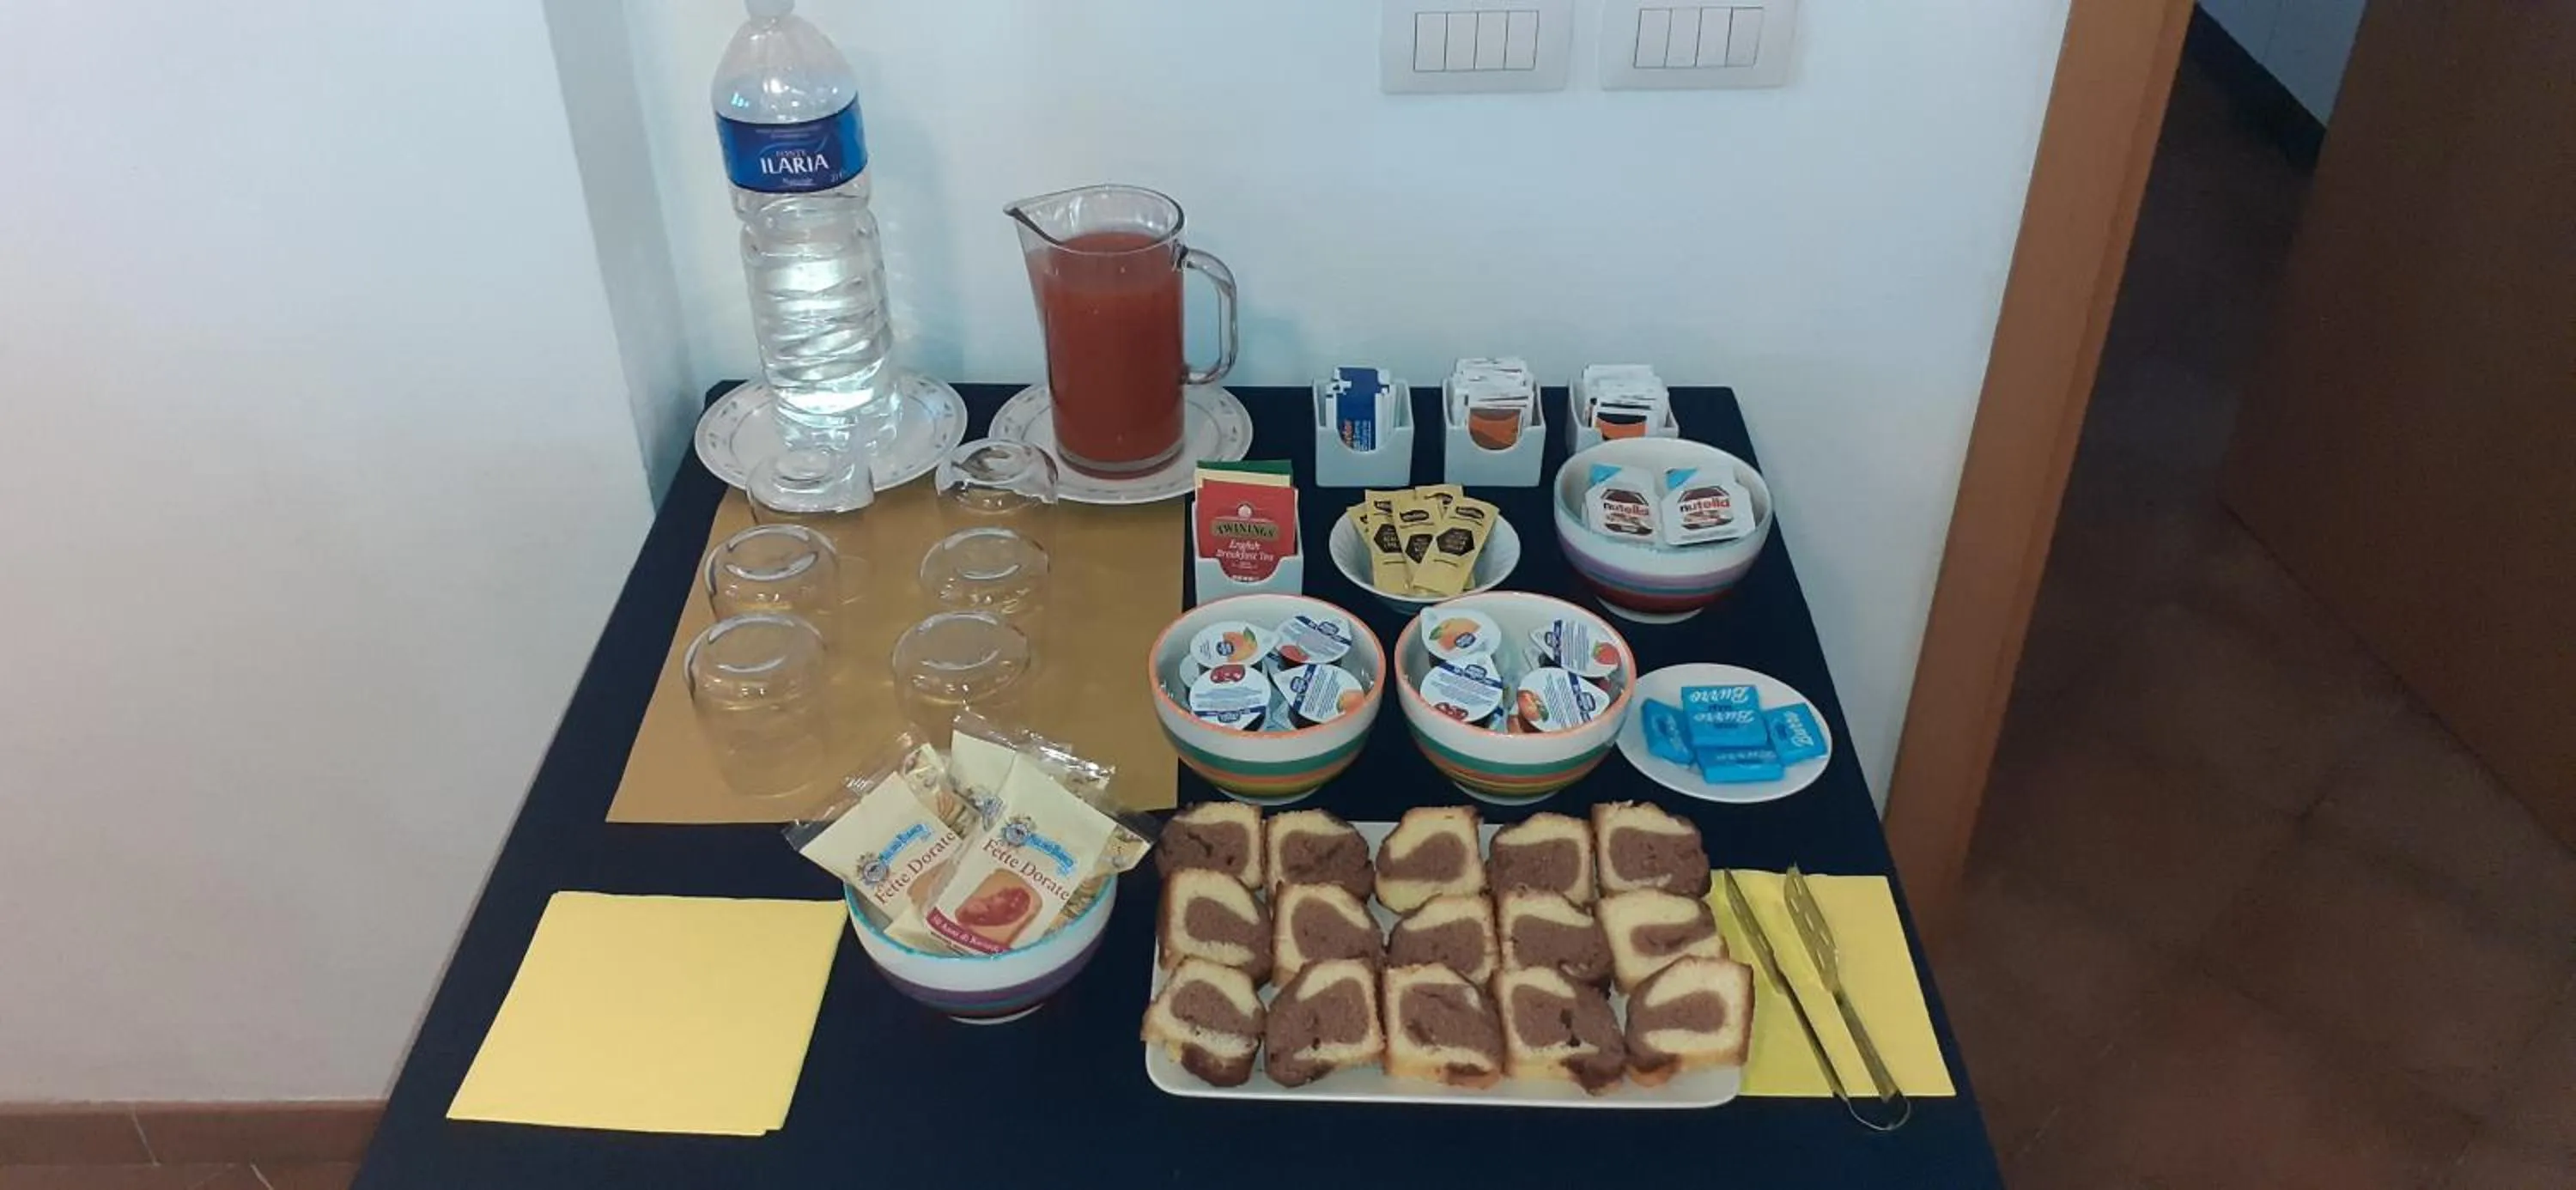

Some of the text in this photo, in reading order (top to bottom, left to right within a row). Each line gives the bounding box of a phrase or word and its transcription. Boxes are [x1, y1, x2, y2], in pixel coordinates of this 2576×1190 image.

[760, 154, 829, 174] ILARIA
[1603, 501, 1649, 517] nutella
[1680, 497, 1731, 513] nutella
[1215, 522, 1275, 537] TWININGS
[1229, 539, 1261, 551] English
[1216, 549, 1256, 561] Breakfast
[1689, 687, 1750, 705] Burro
[1693, 710, 1755, 724] Burro
[874, 873, 910, 904] Fette
[907, 831, 956, 874] Dorate
[982, 837, 1019, 868] Fette
[1020, 860, 1070, 901] Dorate
